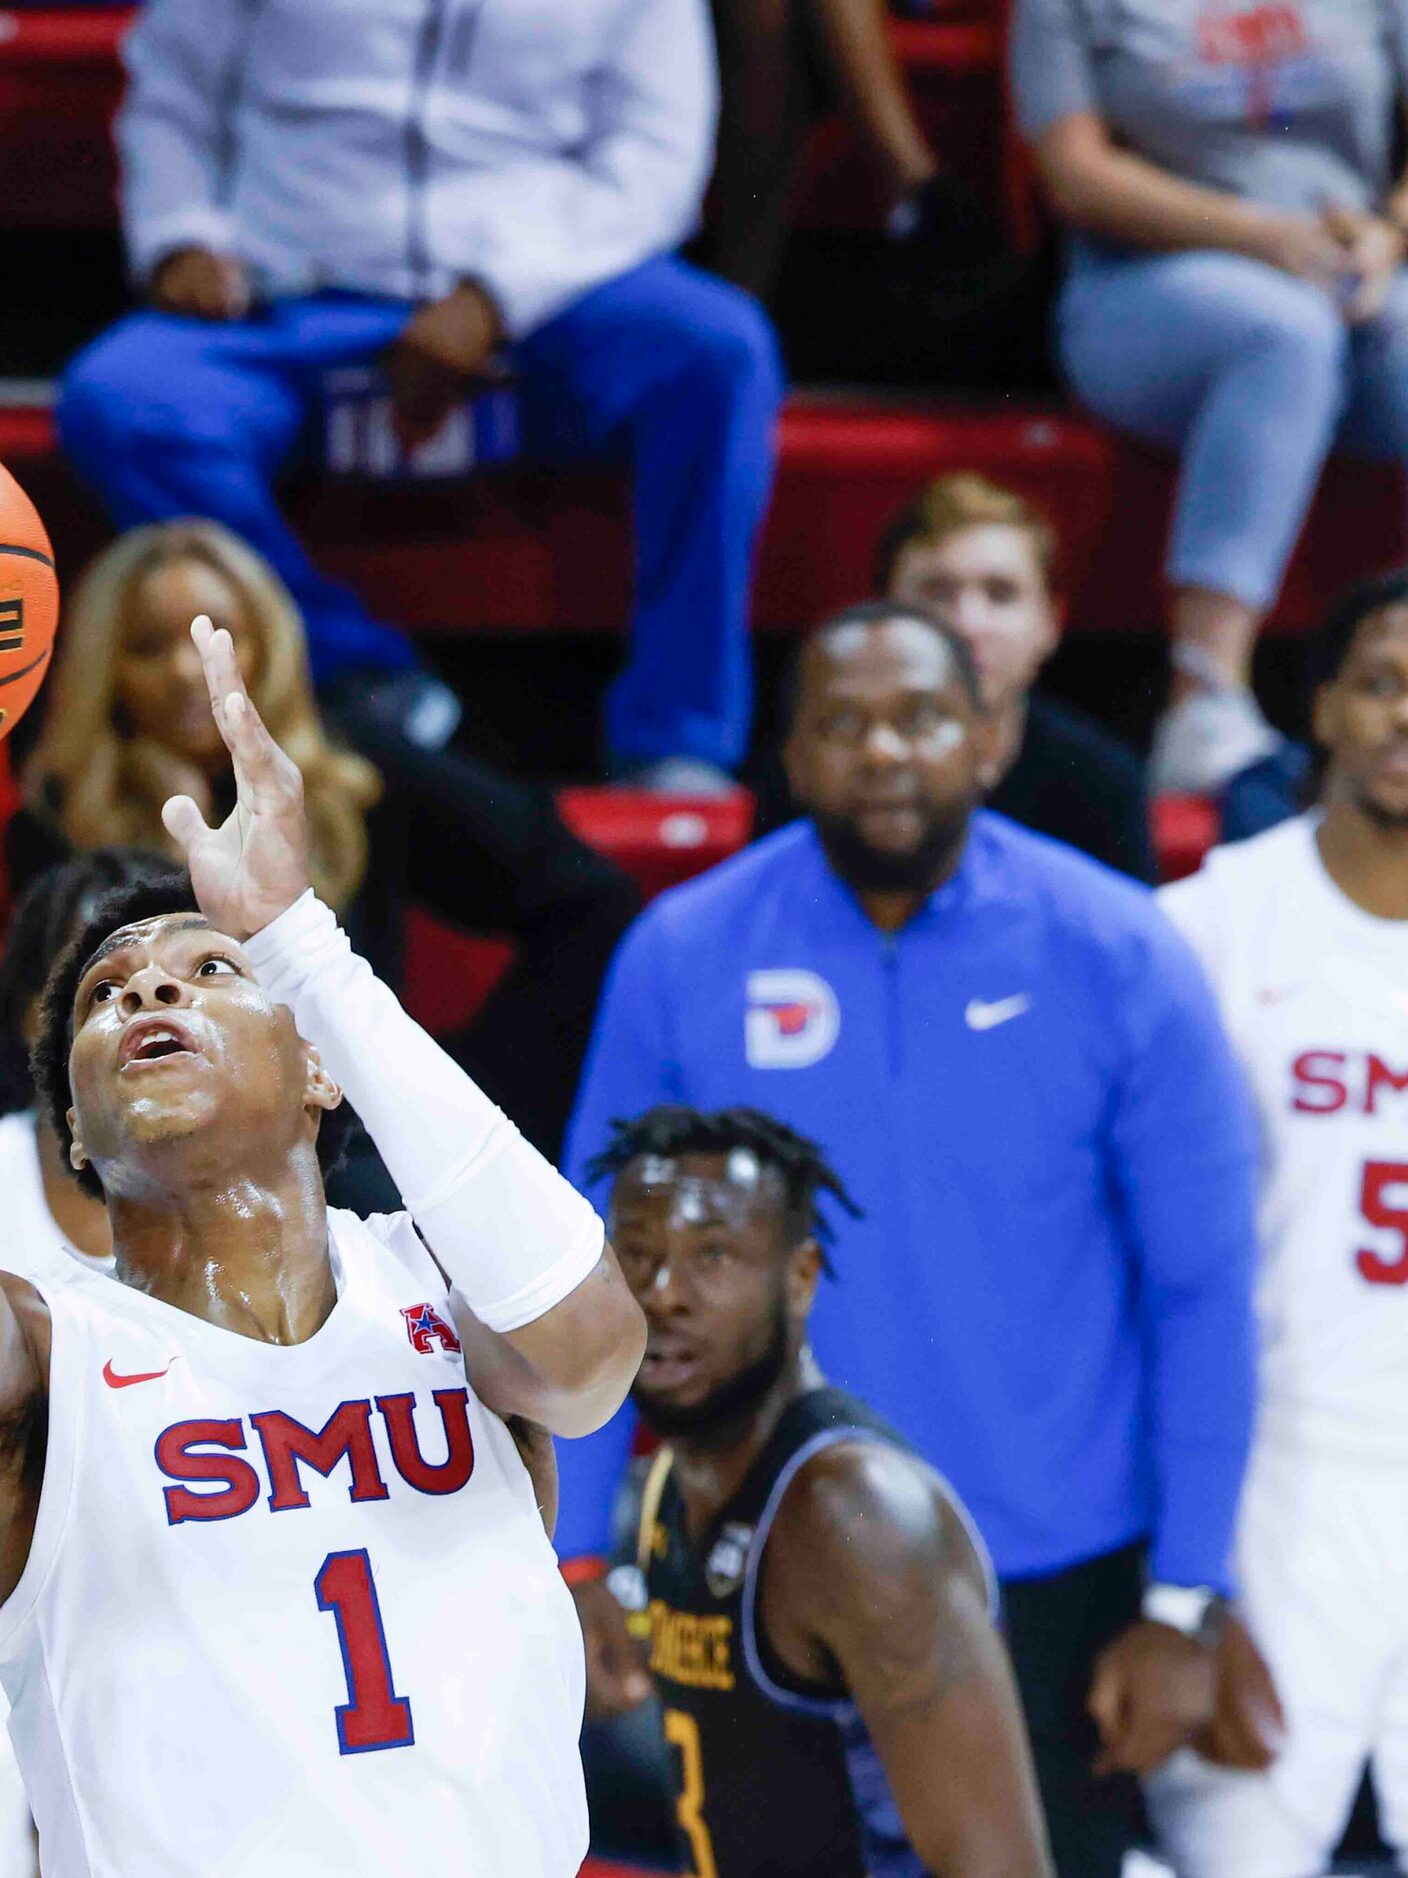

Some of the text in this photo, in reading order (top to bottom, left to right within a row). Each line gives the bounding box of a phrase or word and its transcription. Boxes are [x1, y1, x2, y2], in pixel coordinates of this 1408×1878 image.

[1290, 1049, 1408, 1115] SM
[1354, 1158, 1408, 1286] 5
[154, 1387, 475, 1526] SMU
[313, 1547, 416, 1756] 1
